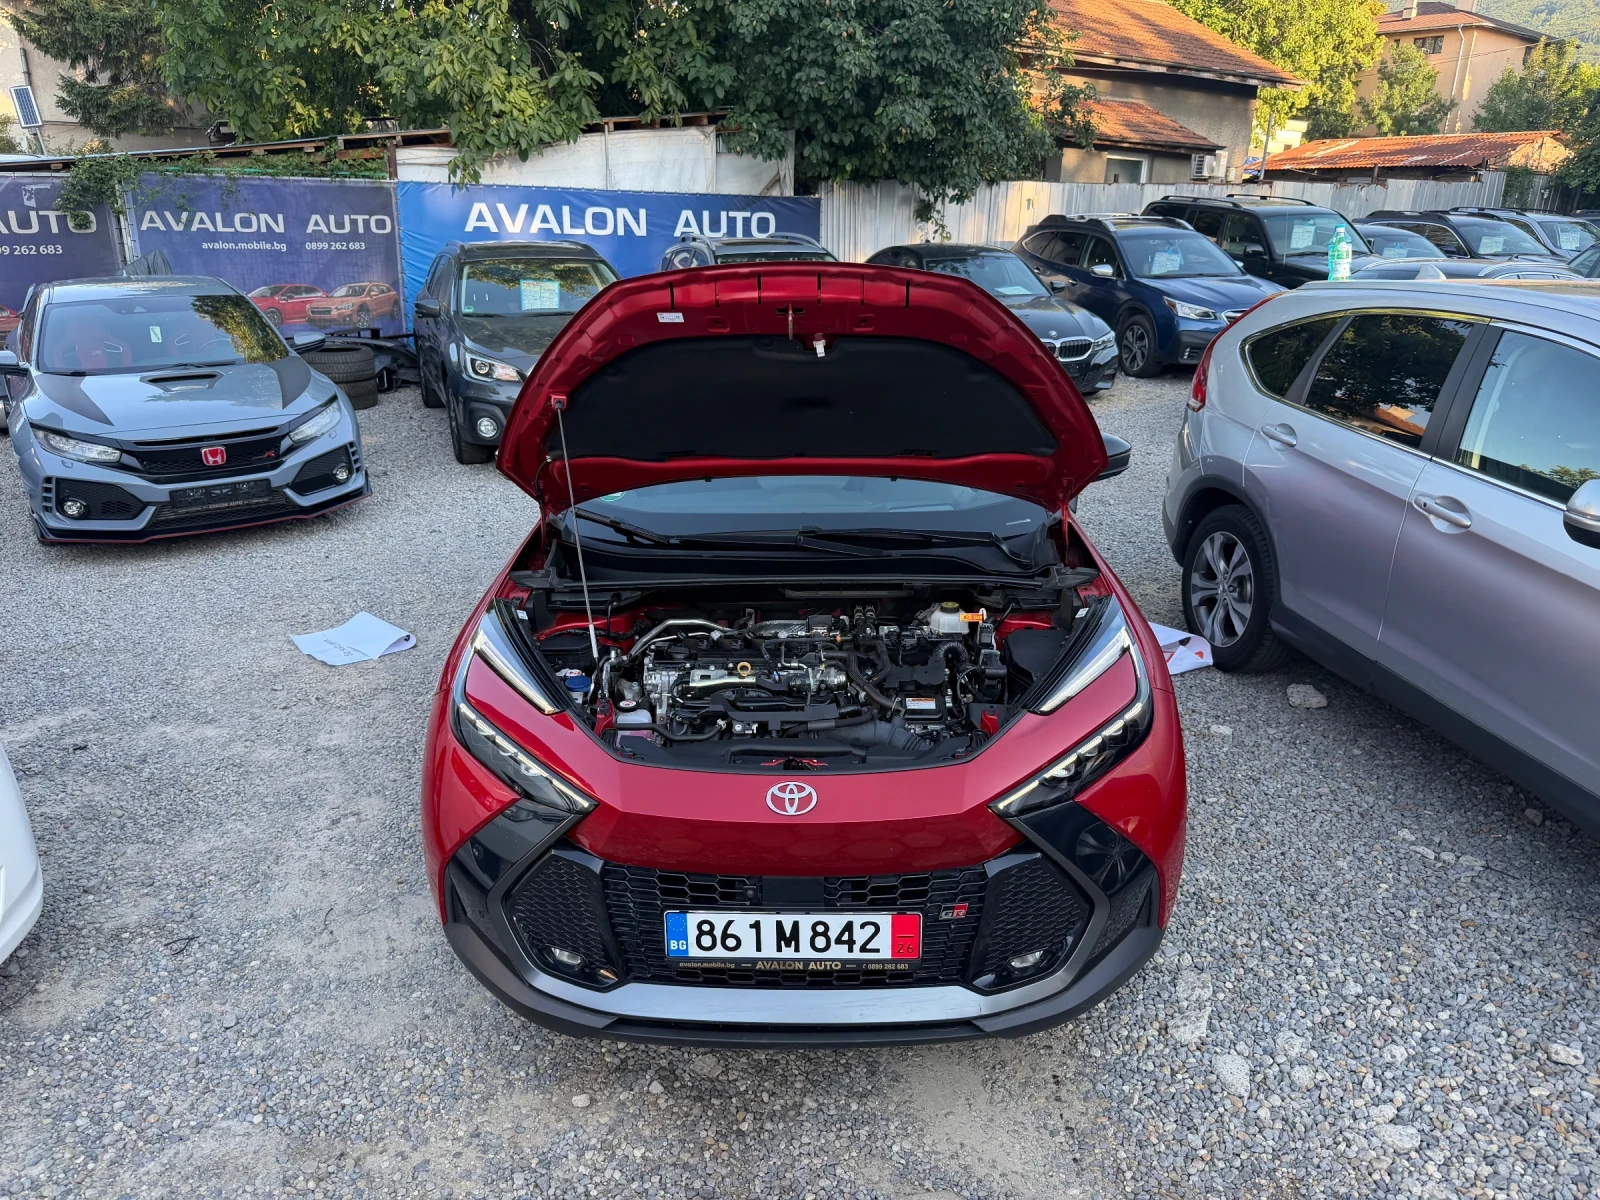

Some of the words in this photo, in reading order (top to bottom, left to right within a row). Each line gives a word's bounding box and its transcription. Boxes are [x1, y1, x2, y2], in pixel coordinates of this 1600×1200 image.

[0, 210, 97, 234] UTO
[141, 210, 285, 233] AVALON
[306, 214, 392, 234] AUTO
[464, 202, 647, 237] AVALON
[674, 209, 777, 238] AUTO
[12, 245, 38, 255] 262
[39, 244, 63, 255] 683
[202, 241, 287, 252] avalon.mobile.bg
[305, 242, 329, 250] 0899
[330, 242, 347, 250] 262
[348, 242, 366, 250] 683
[940, 907, 967, 918] GR
[670, 939, 687, 950] BG
[896, 943, 915, 954] 26
[679, 961, 735, 969] avalon.mobile.bg
[756, 960, 803, 970] AVALON
[808, 961, 842, 970] AUTO
